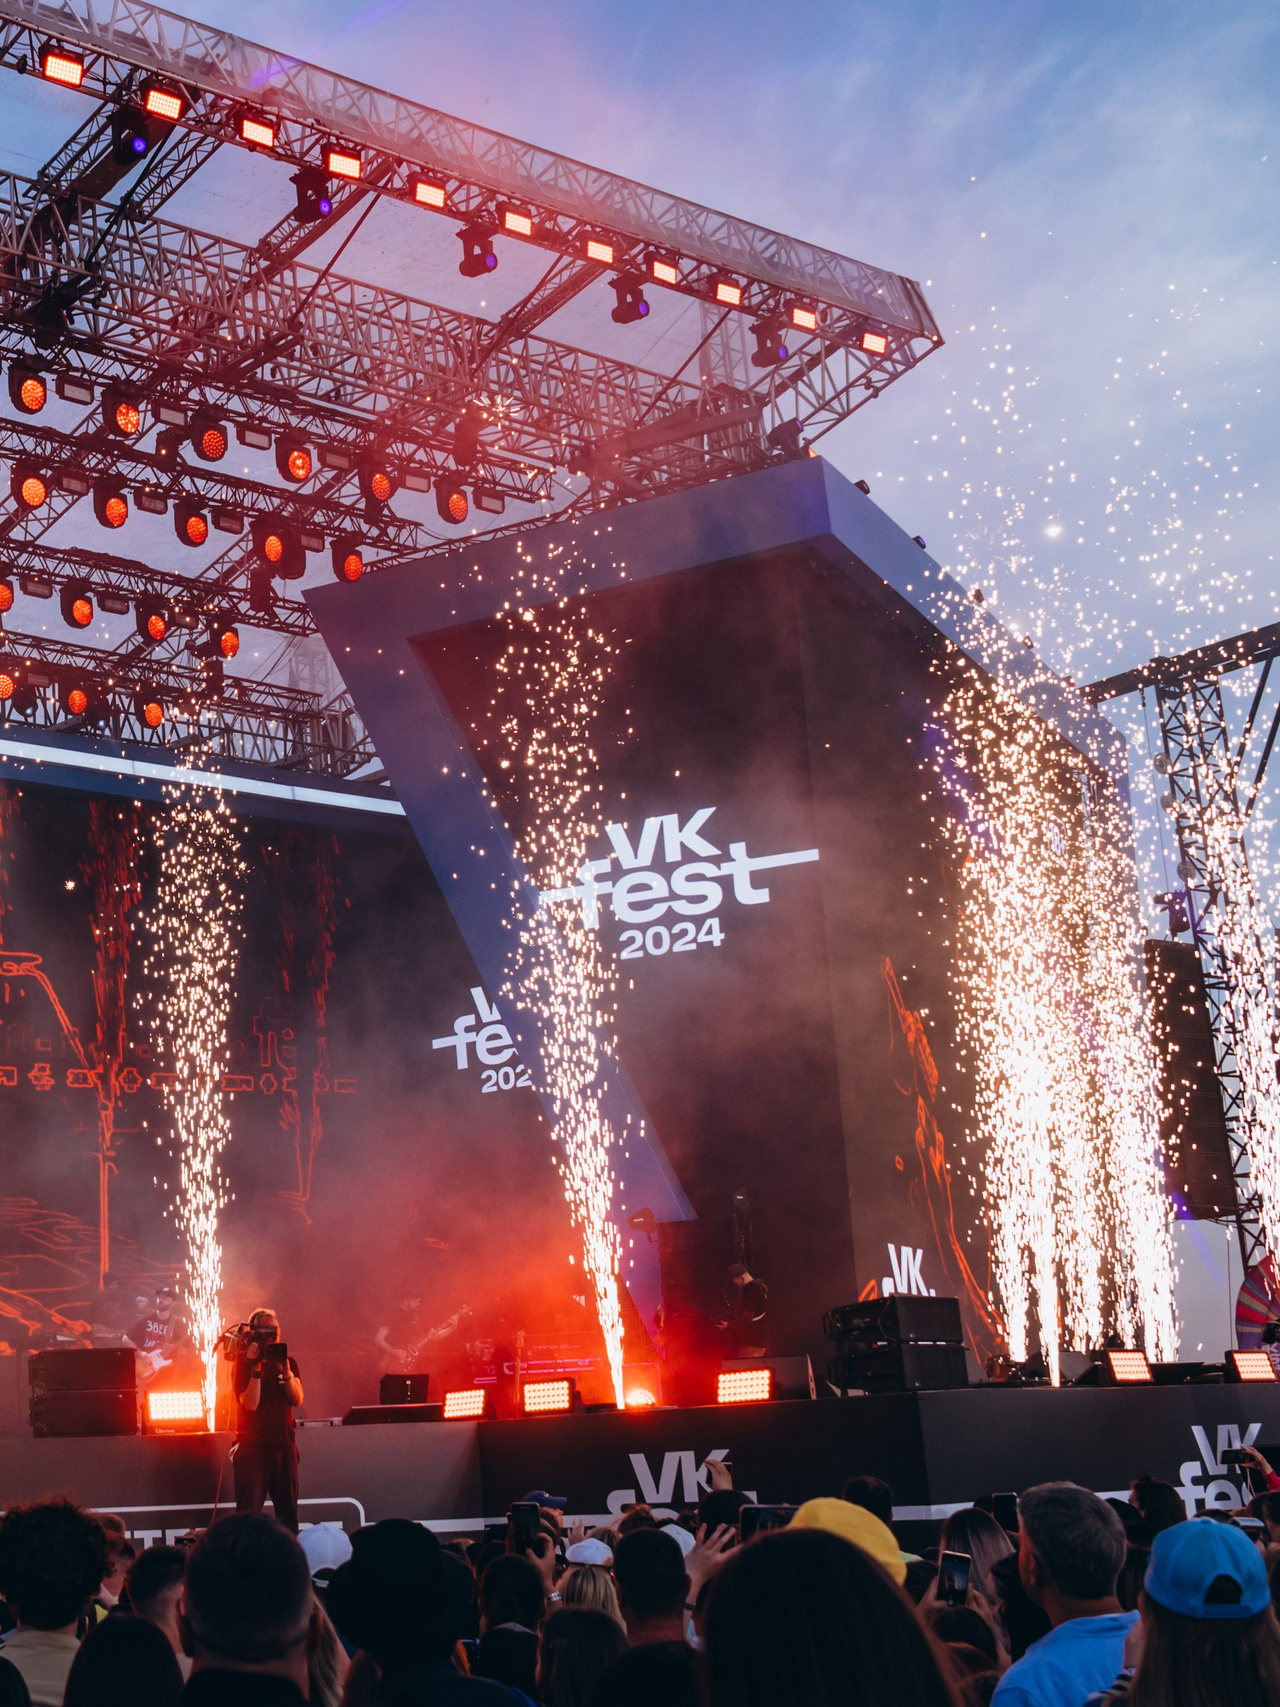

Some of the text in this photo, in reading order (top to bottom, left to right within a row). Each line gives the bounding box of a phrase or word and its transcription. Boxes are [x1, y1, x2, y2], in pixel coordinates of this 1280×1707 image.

[605, 807, 722, 869] VK
[540, 841, 819, 930] fest
[619, 918, 725, 960] 2024
[887, 1243, 929, 1296] VK
[629, 1449, 730, 1503] VK
